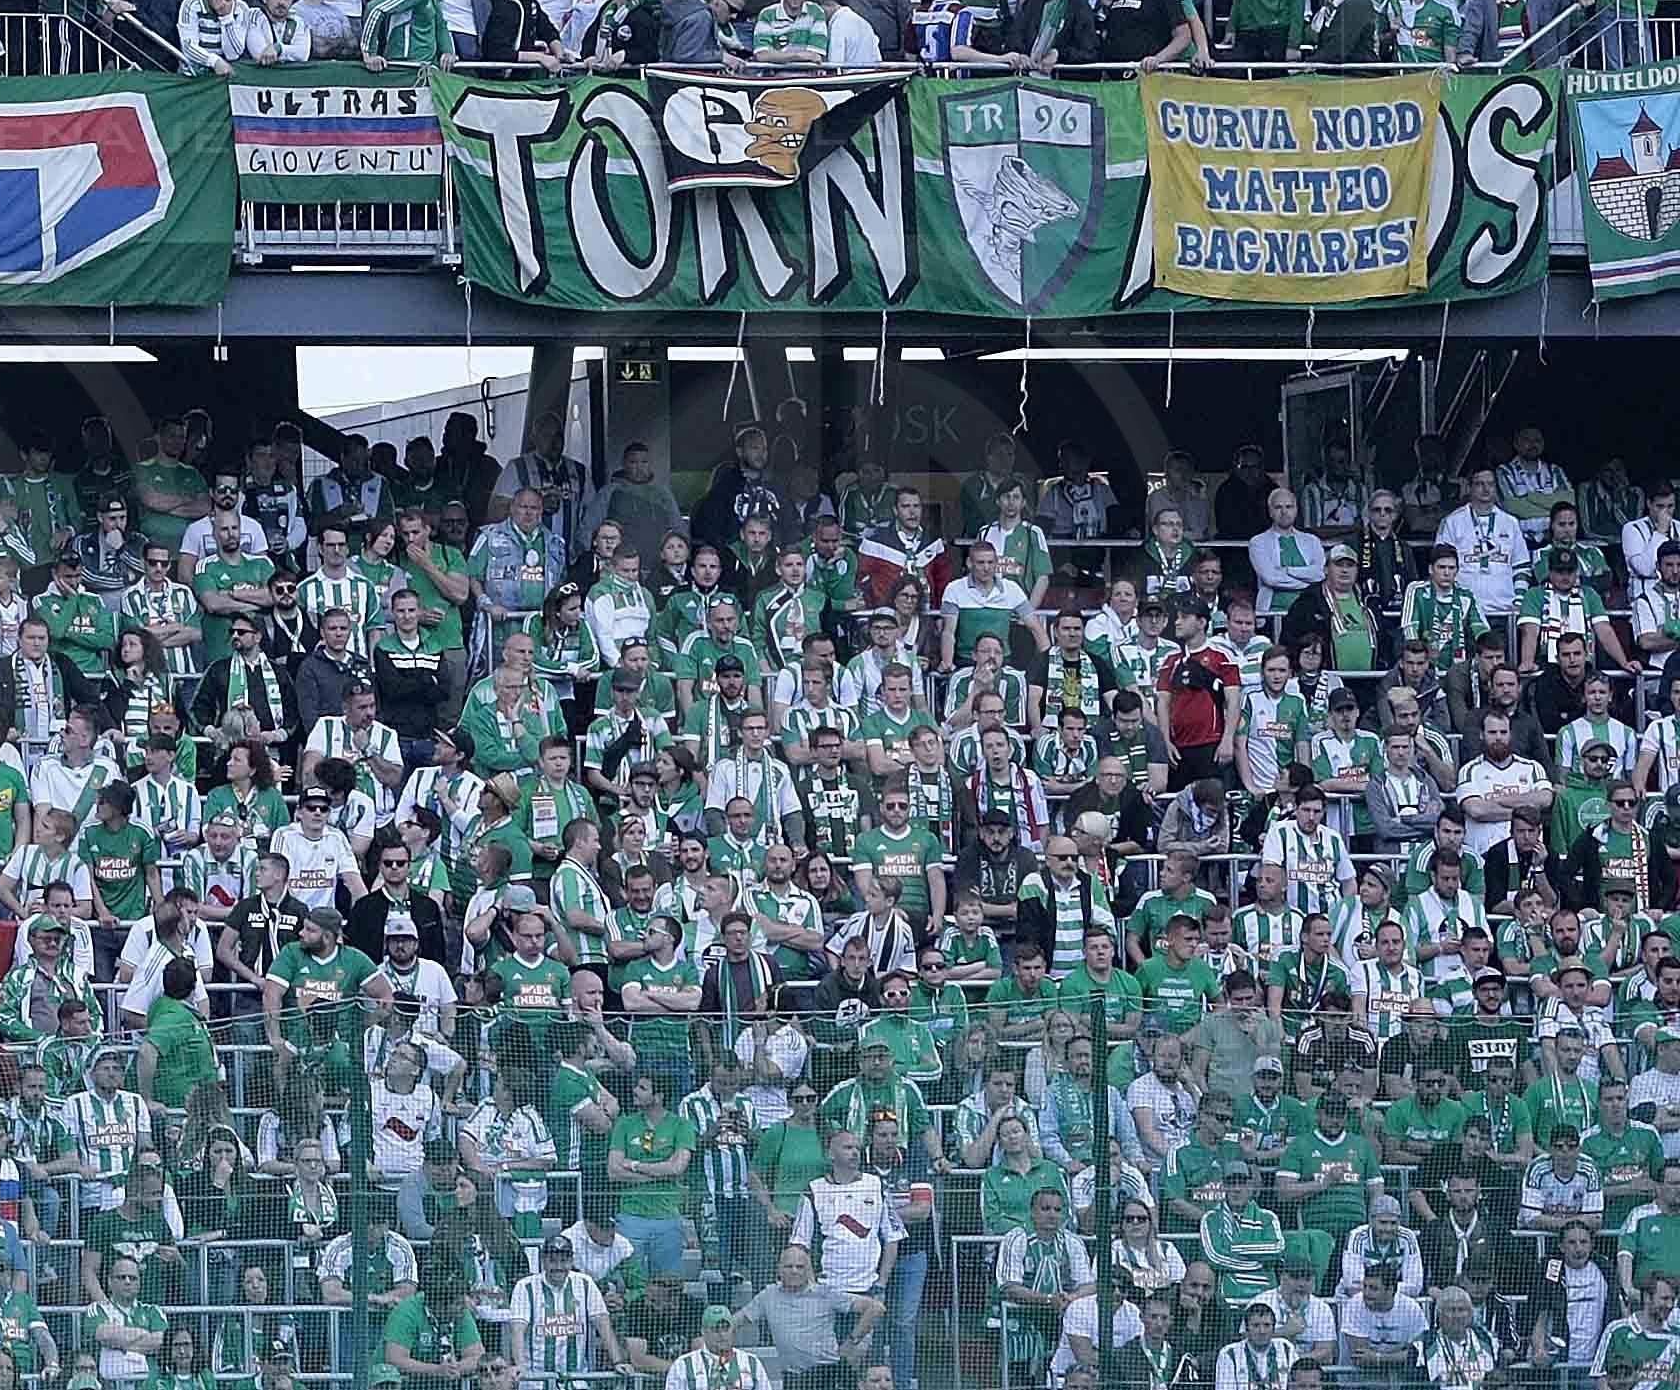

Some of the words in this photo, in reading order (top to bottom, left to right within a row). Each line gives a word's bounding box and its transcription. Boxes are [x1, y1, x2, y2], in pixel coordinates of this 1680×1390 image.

[257, 89, 417, 117] ULTRAS
[956, 104, 1006, 131] TR
[1034, 105, 1080, 135] 96
[1159, 100, 1297, 150] CURVA
[1313, 101, 1423, 152] NORD
[1201, 164, 1391, 215] MATTEO
[100, 859, 129, 868] WIEN
